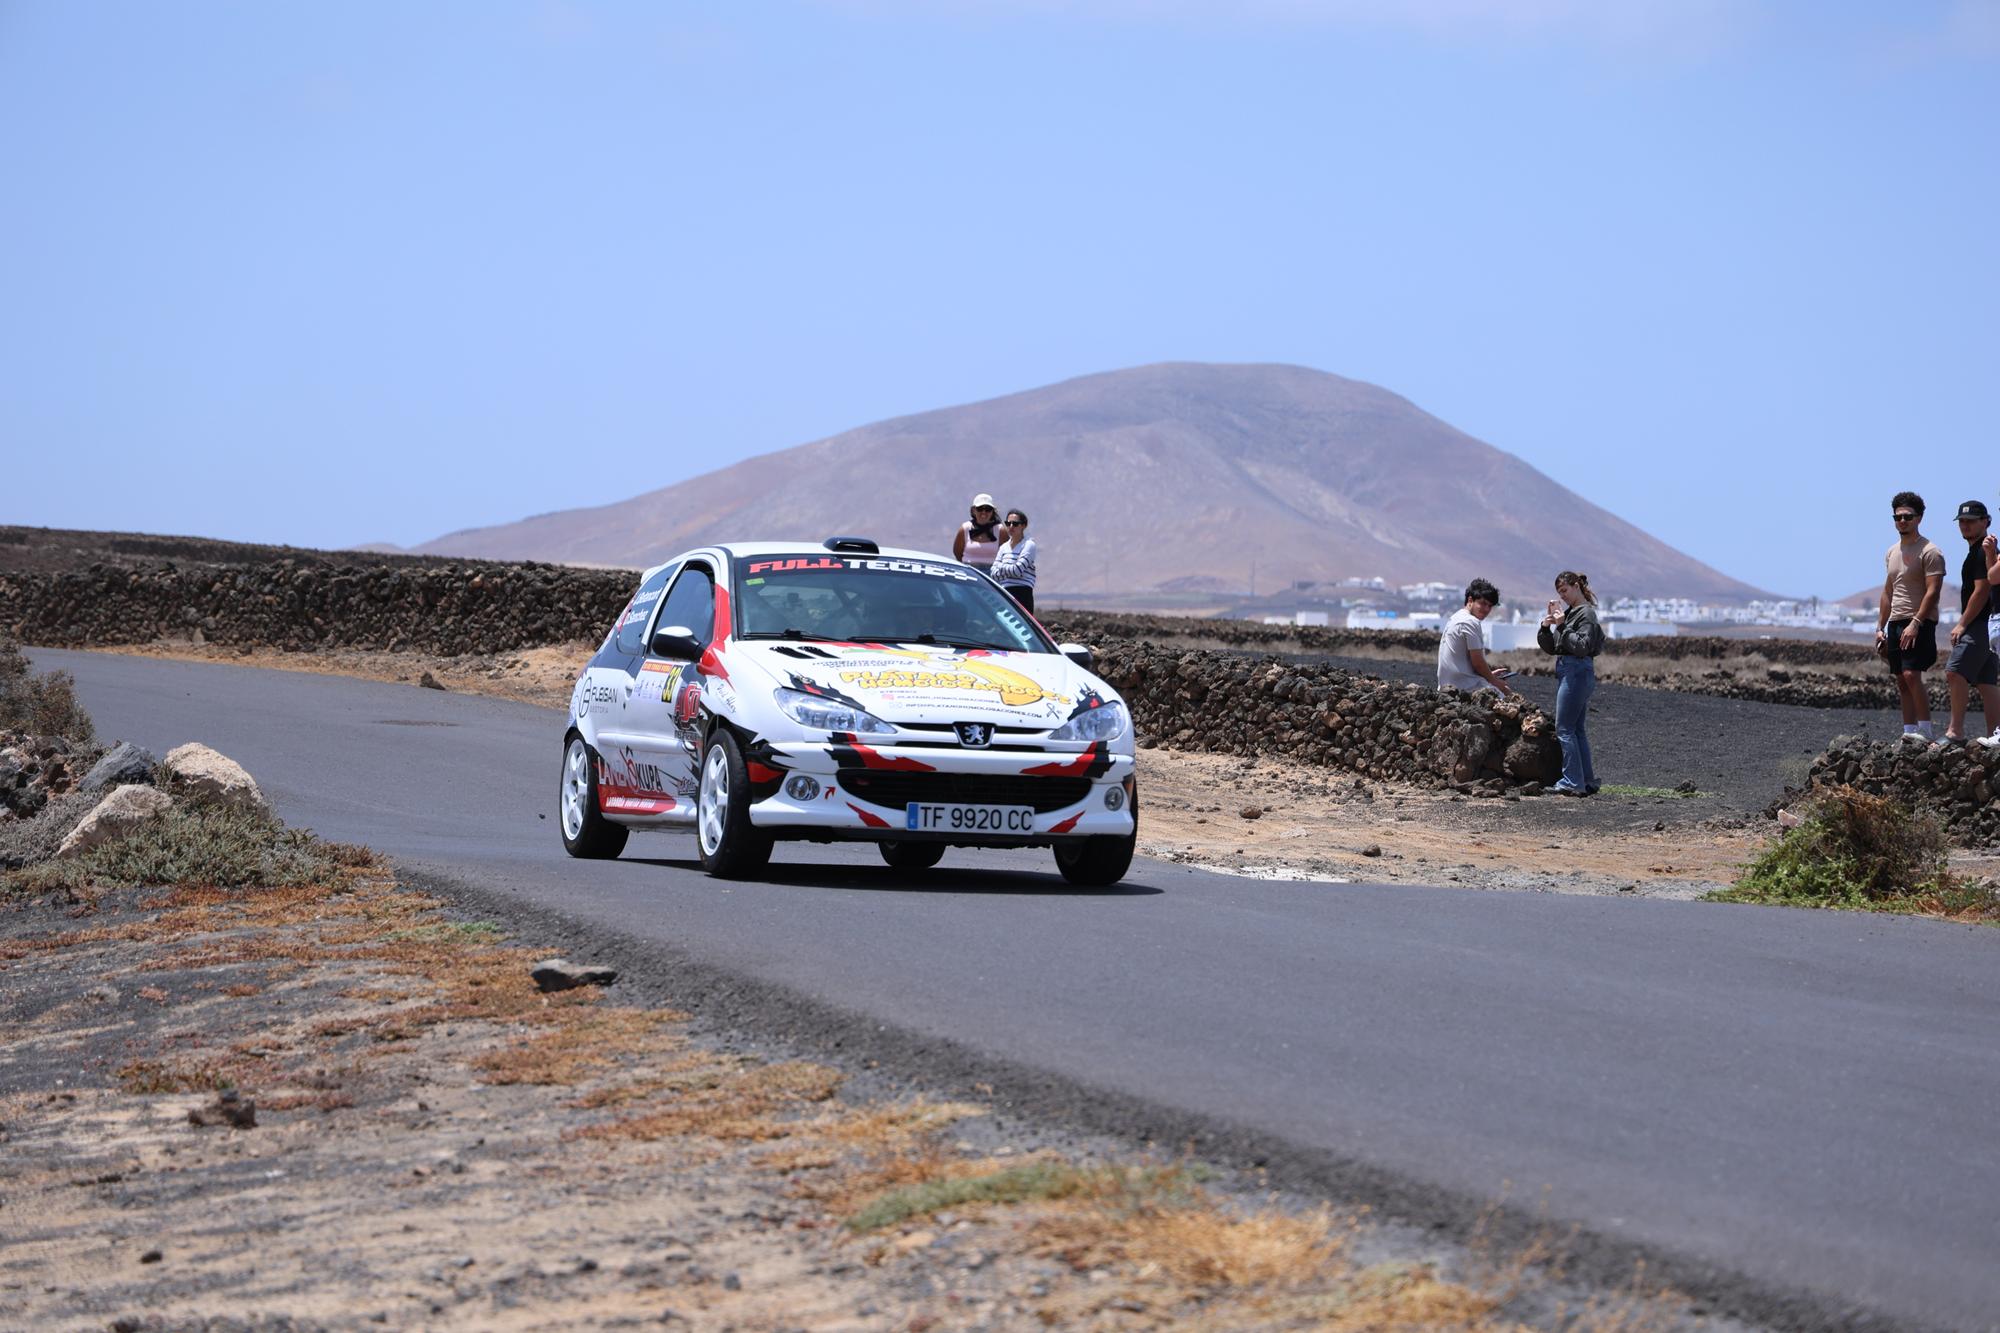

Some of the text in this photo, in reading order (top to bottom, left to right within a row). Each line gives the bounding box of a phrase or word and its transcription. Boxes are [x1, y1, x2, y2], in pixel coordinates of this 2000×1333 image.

[920, 807, 1033, 831] TF 9920 CC
